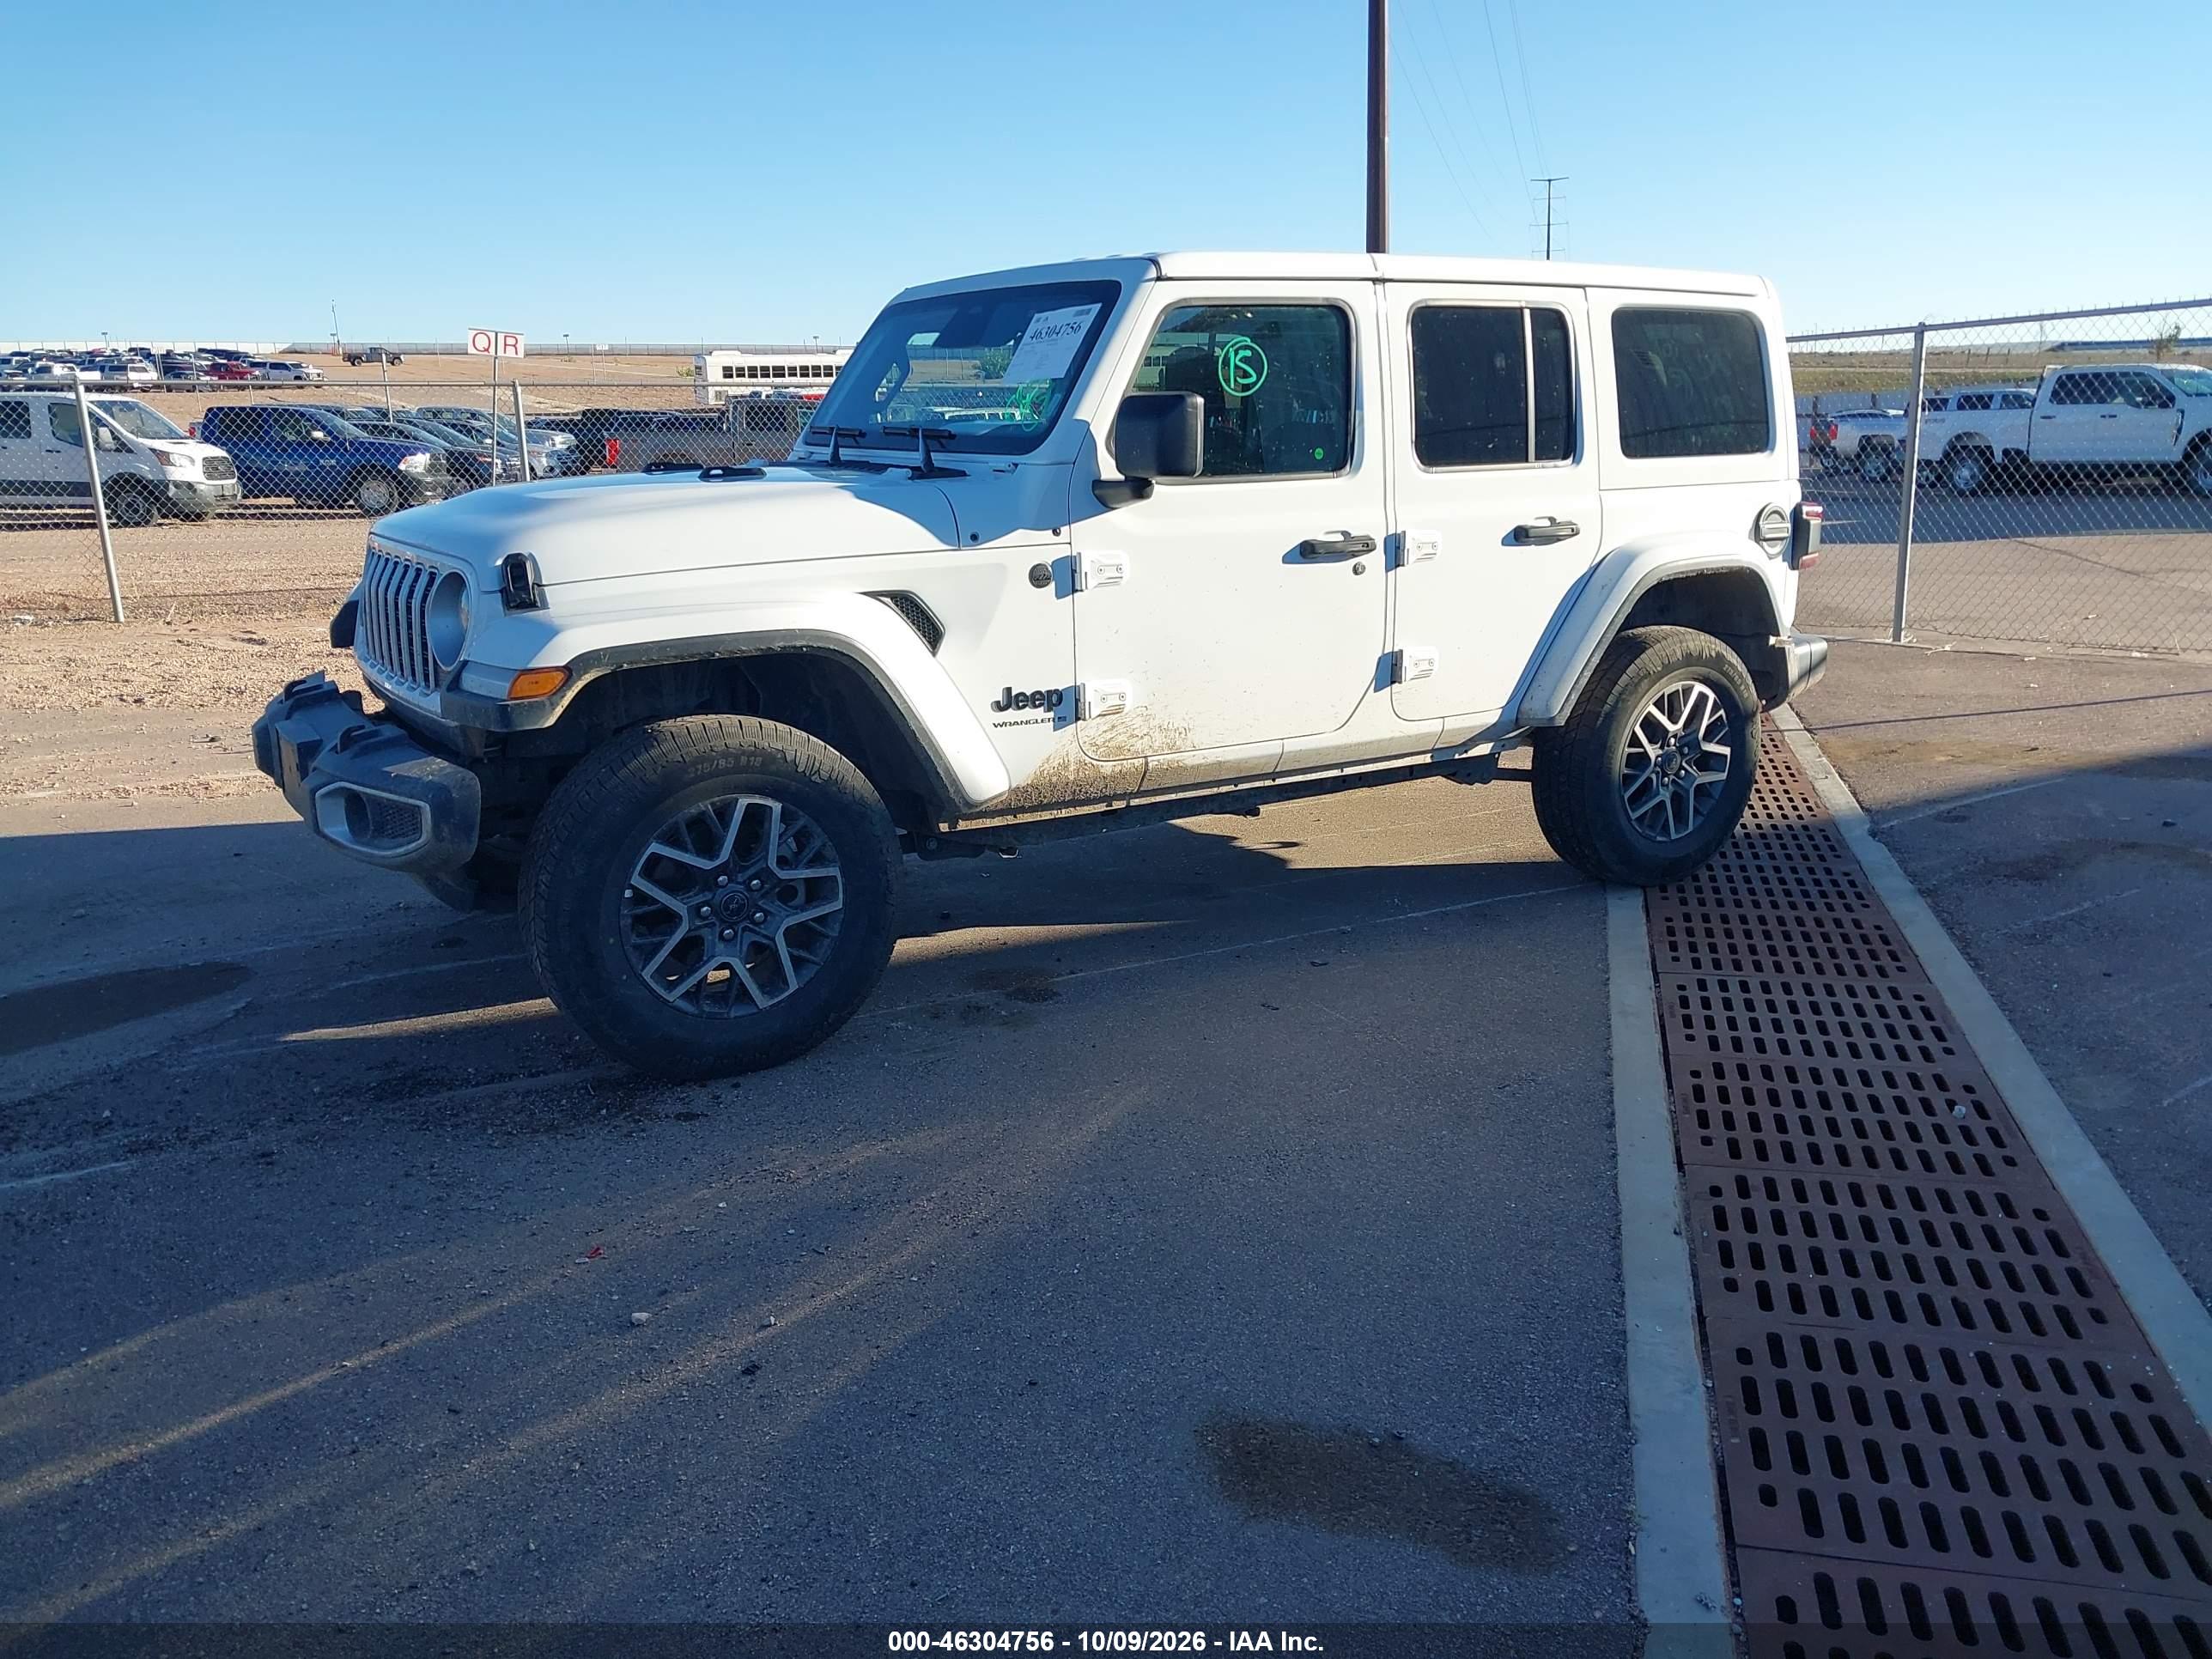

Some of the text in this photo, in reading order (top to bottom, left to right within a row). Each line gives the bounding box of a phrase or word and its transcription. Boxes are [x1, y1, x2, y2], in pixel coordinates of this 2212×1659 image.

[1030, 321, 1083, 341] 46304756
[472, 331, 519, 356] Q R
[991, 686, 1063, 713] Jeep
[993, 717, 1056, 728] WRANGLER
